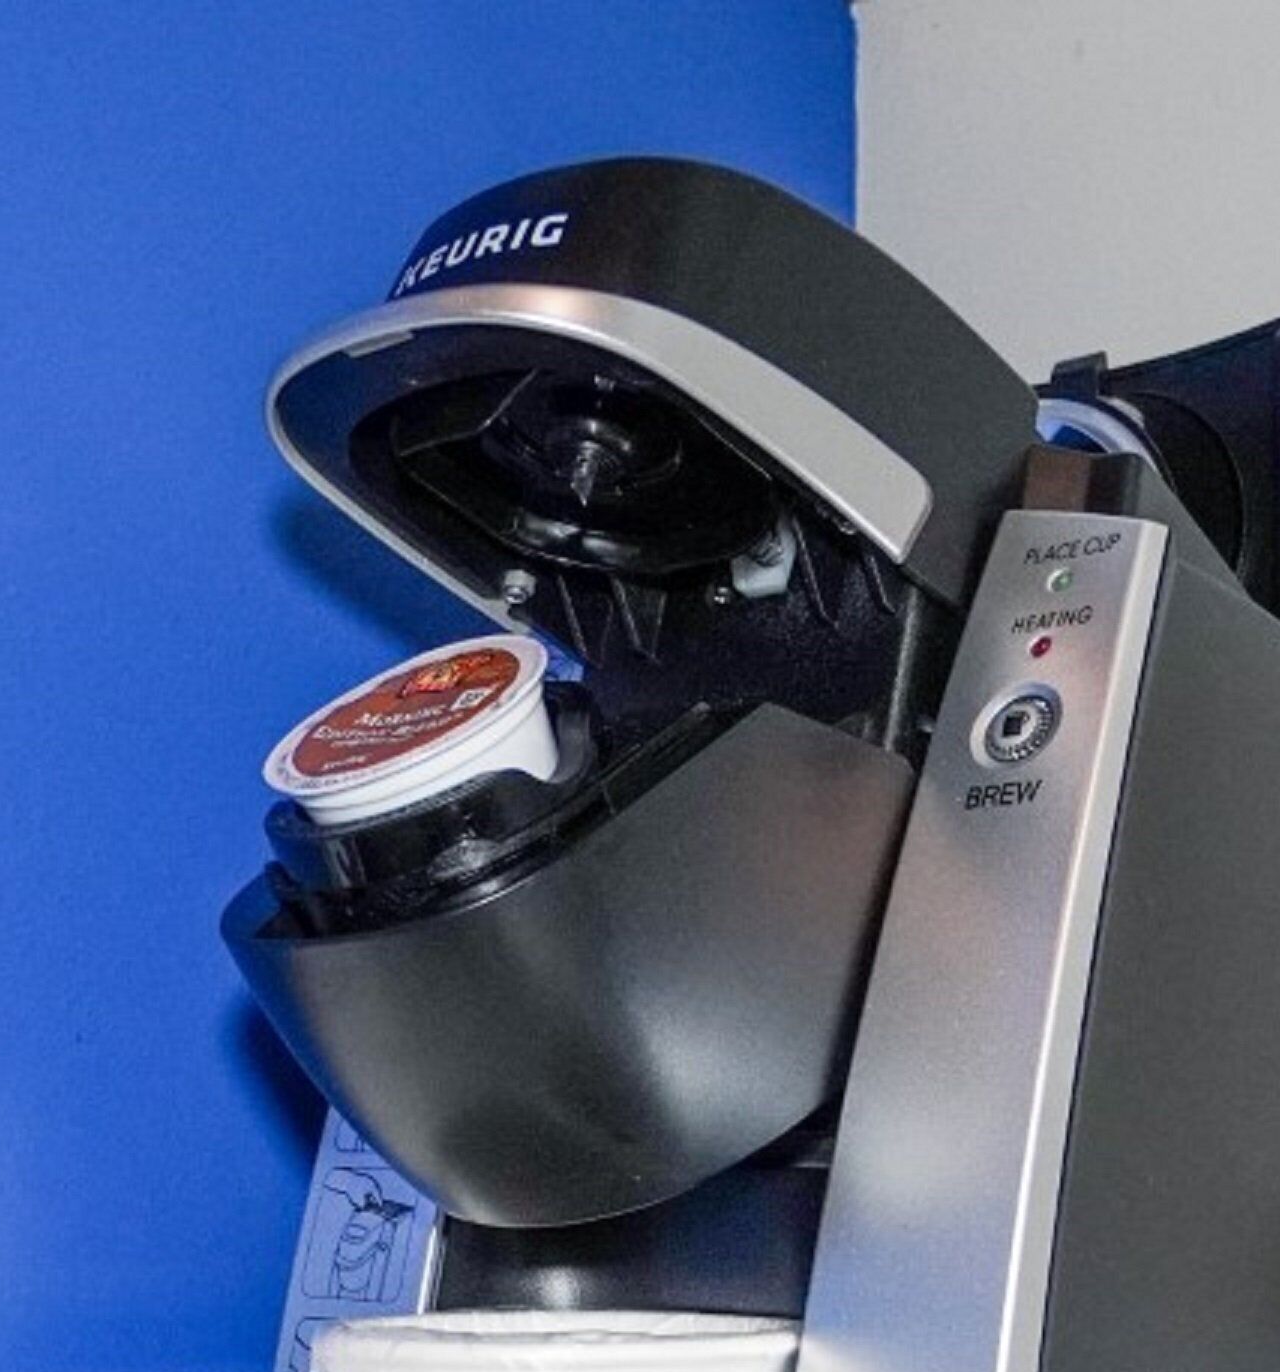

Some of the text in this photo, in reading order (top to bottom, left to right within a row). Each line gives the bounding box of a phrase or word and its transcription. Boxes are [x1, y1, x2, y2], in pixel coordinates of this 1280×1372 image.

[394, 212, 570, 299] KEURIG
[1022, 532, 1122, 566] PLACE CUP
[1010, 604, 1094, 634] HEATING
[964, 778, 1044, 812] BREW
